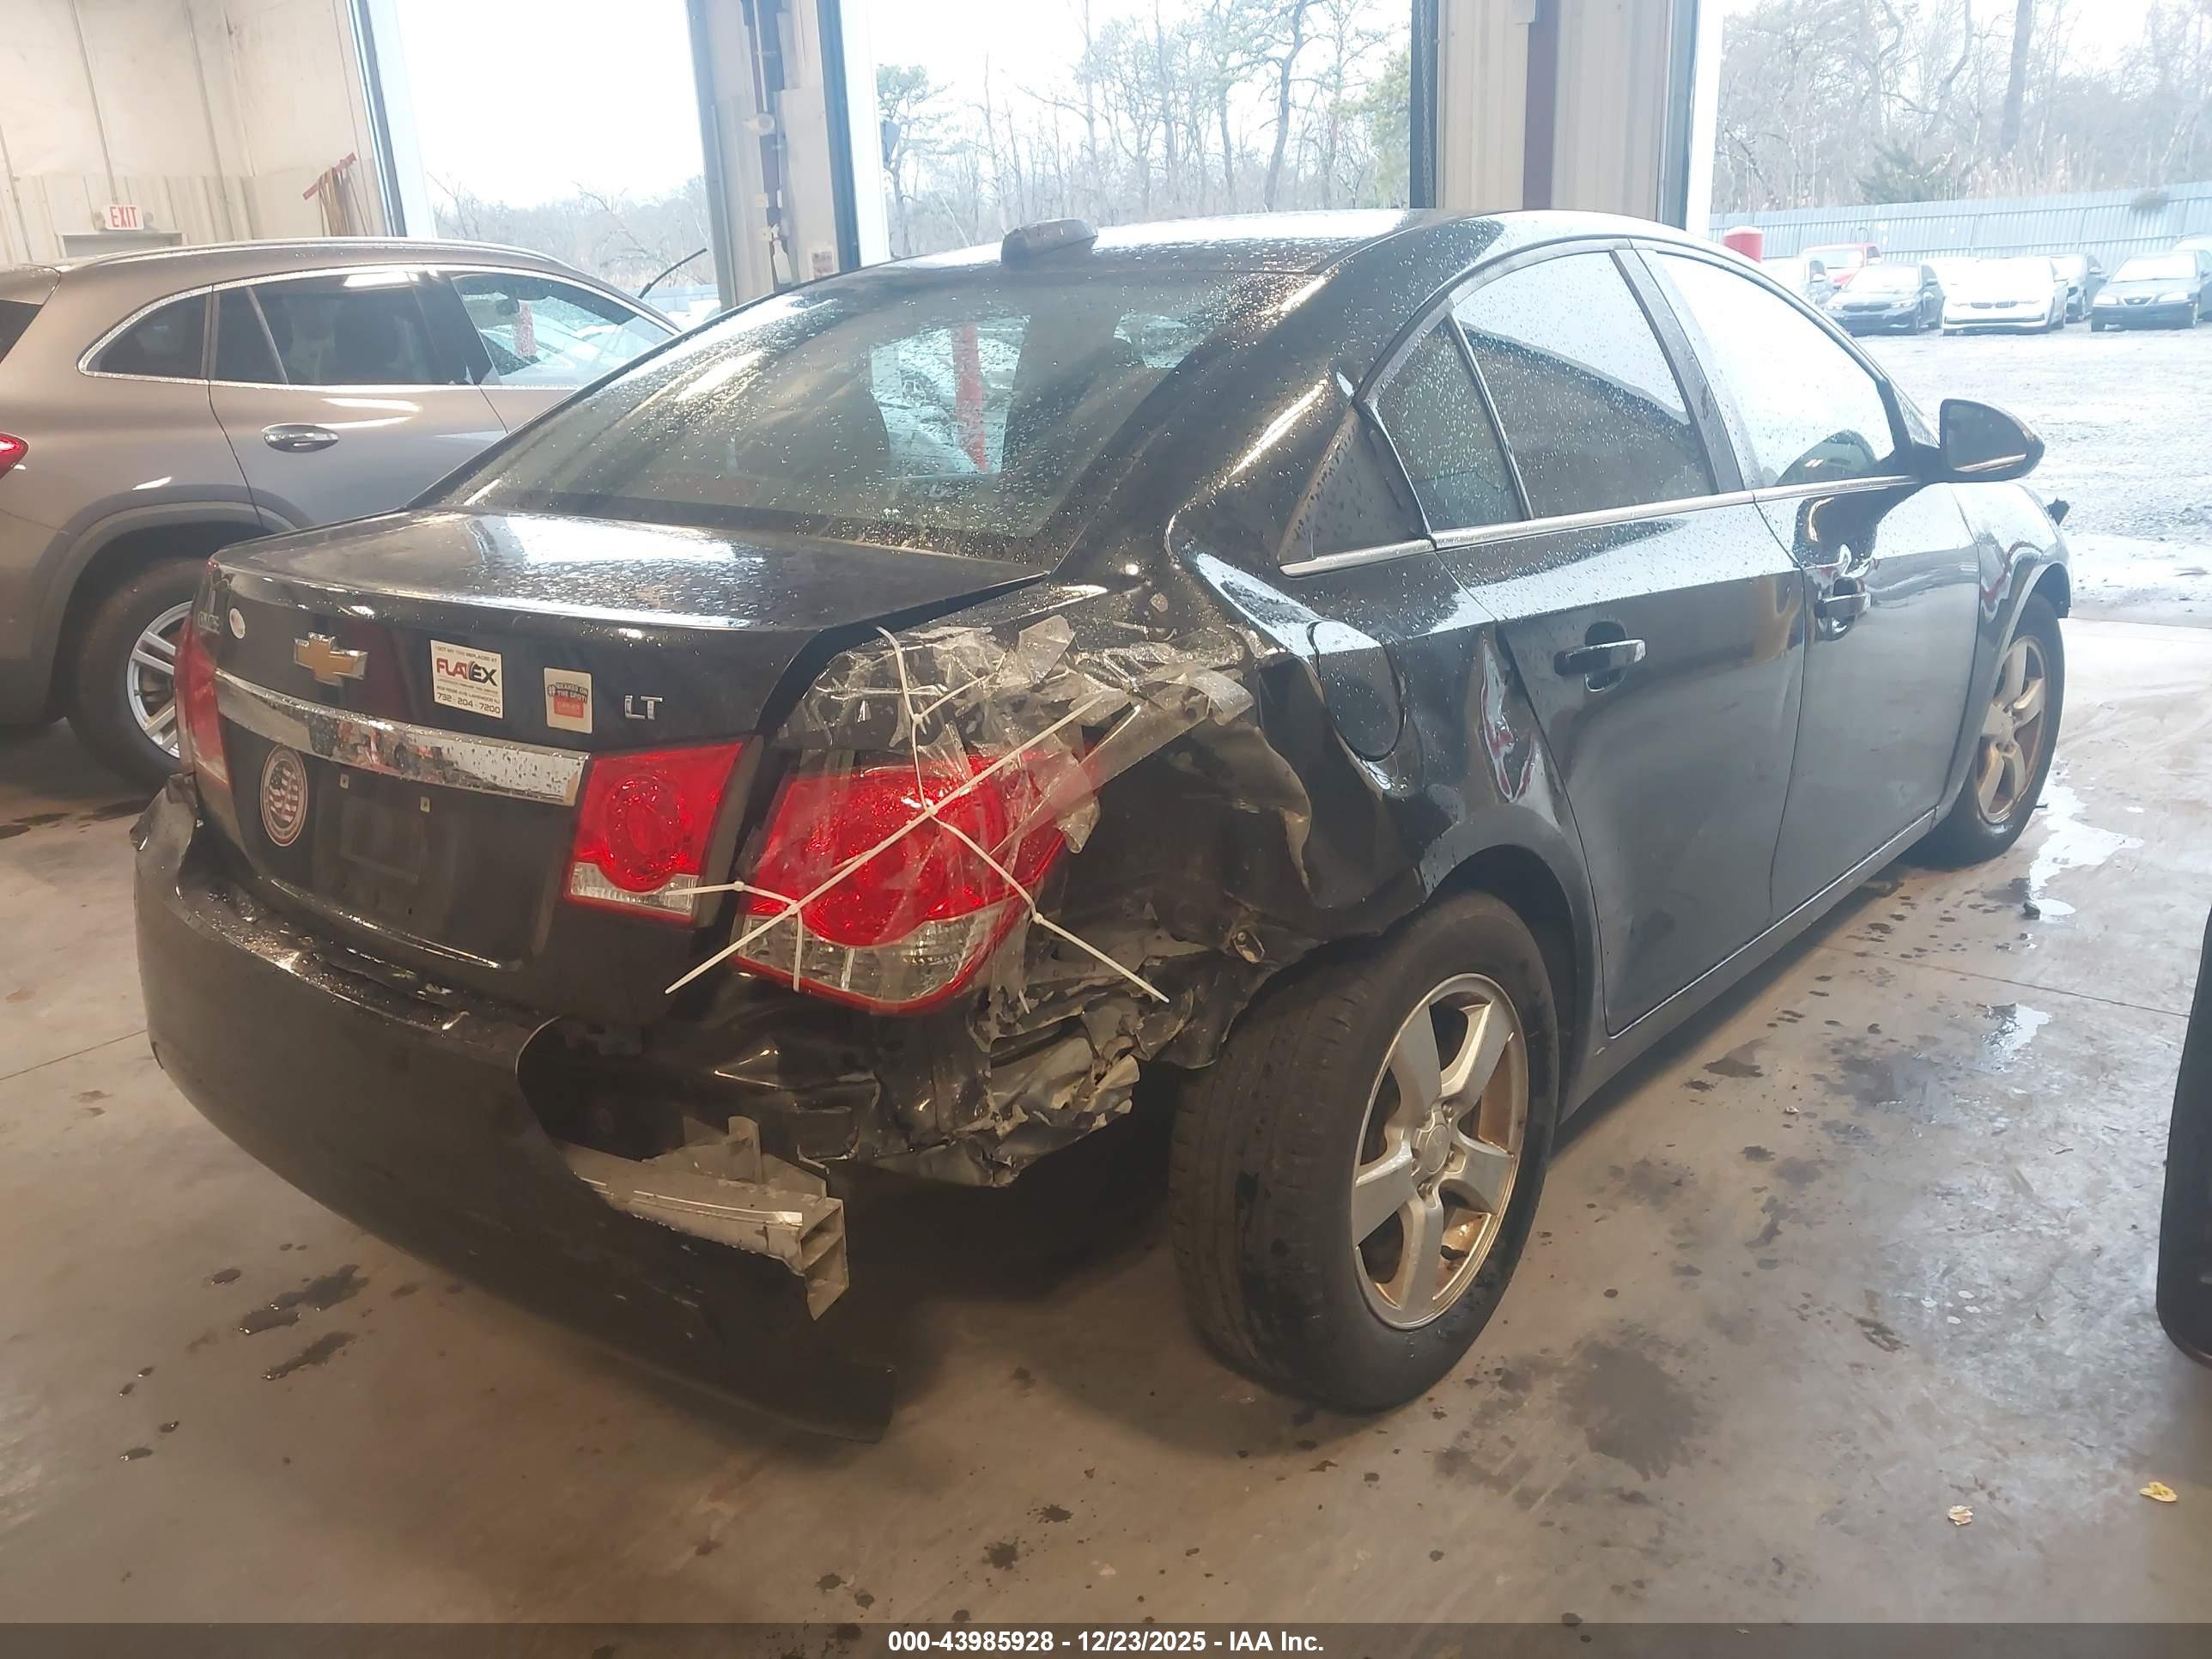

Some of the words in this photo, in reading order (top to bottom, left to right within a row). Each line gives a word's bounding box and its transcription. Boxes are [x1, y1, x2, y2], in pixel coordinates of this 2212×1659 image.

[109, 206, 137, 228] EXIT
[437, 692, 452, 702] 732
[457, 696, 474, 708] 204
[479, 702, 501, 714] 7200
[557, 690, 569, 699] THE
[624, 695, 664, 720] LT
